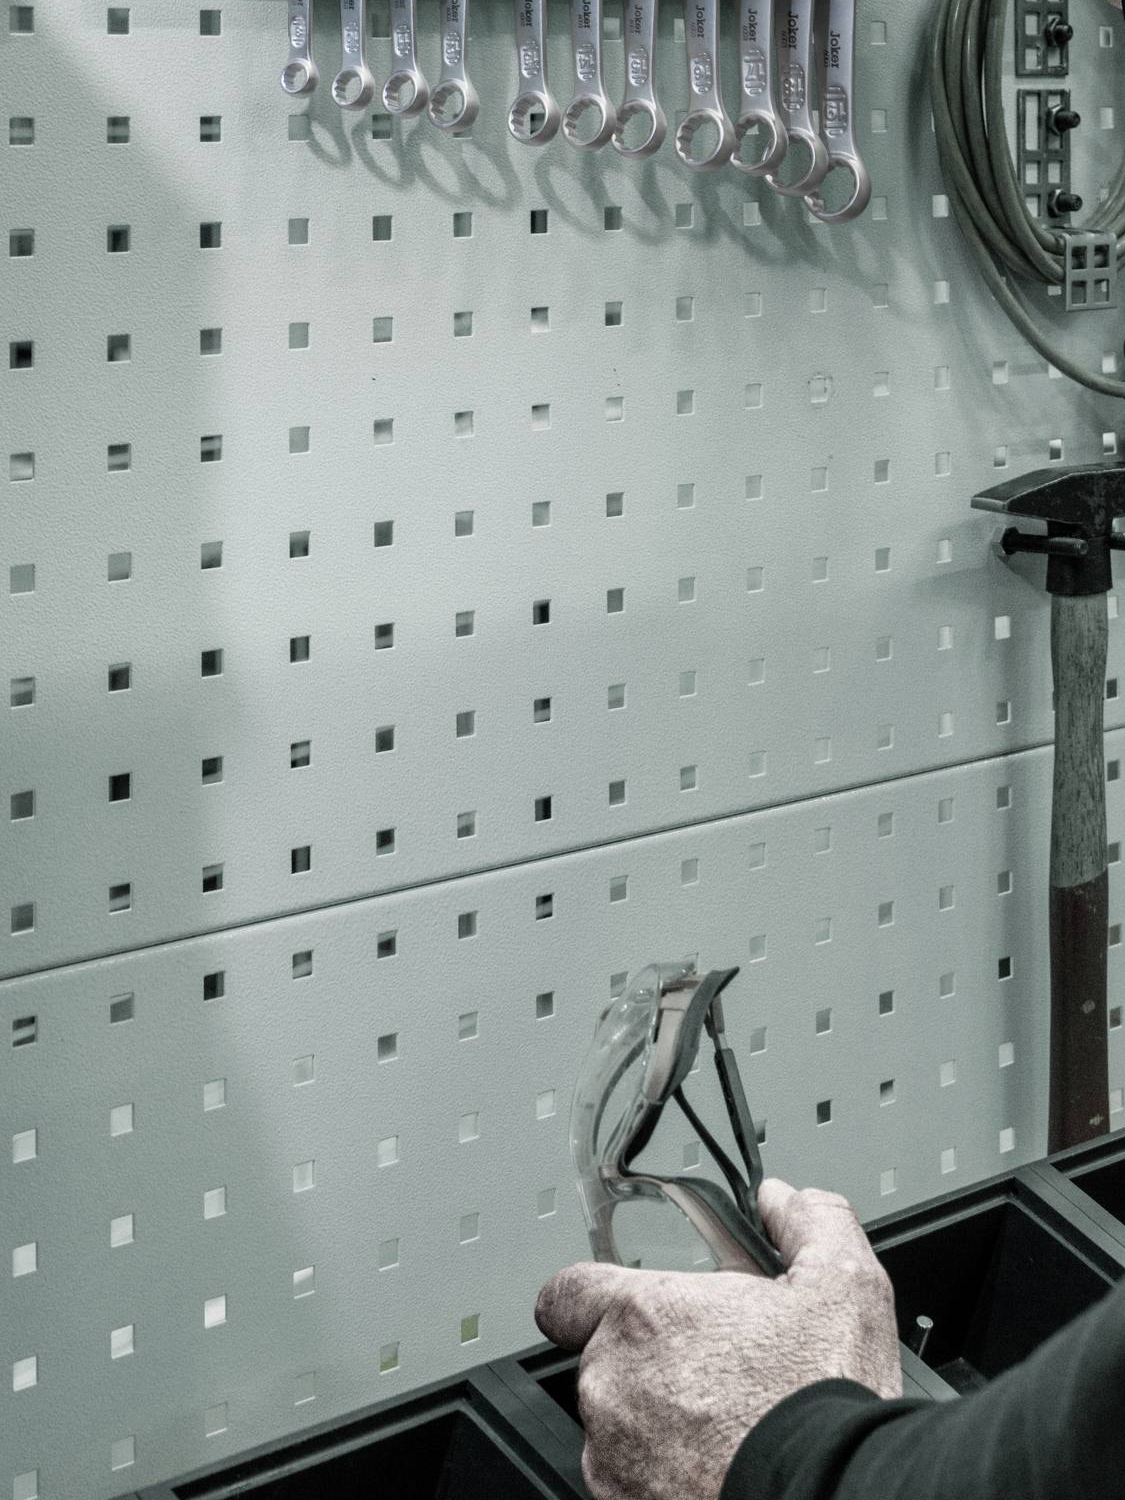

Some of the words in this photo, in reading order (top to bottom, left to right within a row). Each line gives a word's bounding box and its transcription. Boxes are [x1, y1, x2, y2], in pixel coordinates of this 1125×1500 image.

[582, 0, 591, 29] Joker
[634, 4, 643, 34] Joker
[696, 4, 705, 38] Joker
[748, 8, 758, 42] Joker
[788, 11, 799, 50] Joker
[830, 30, 841, 68] Joker
